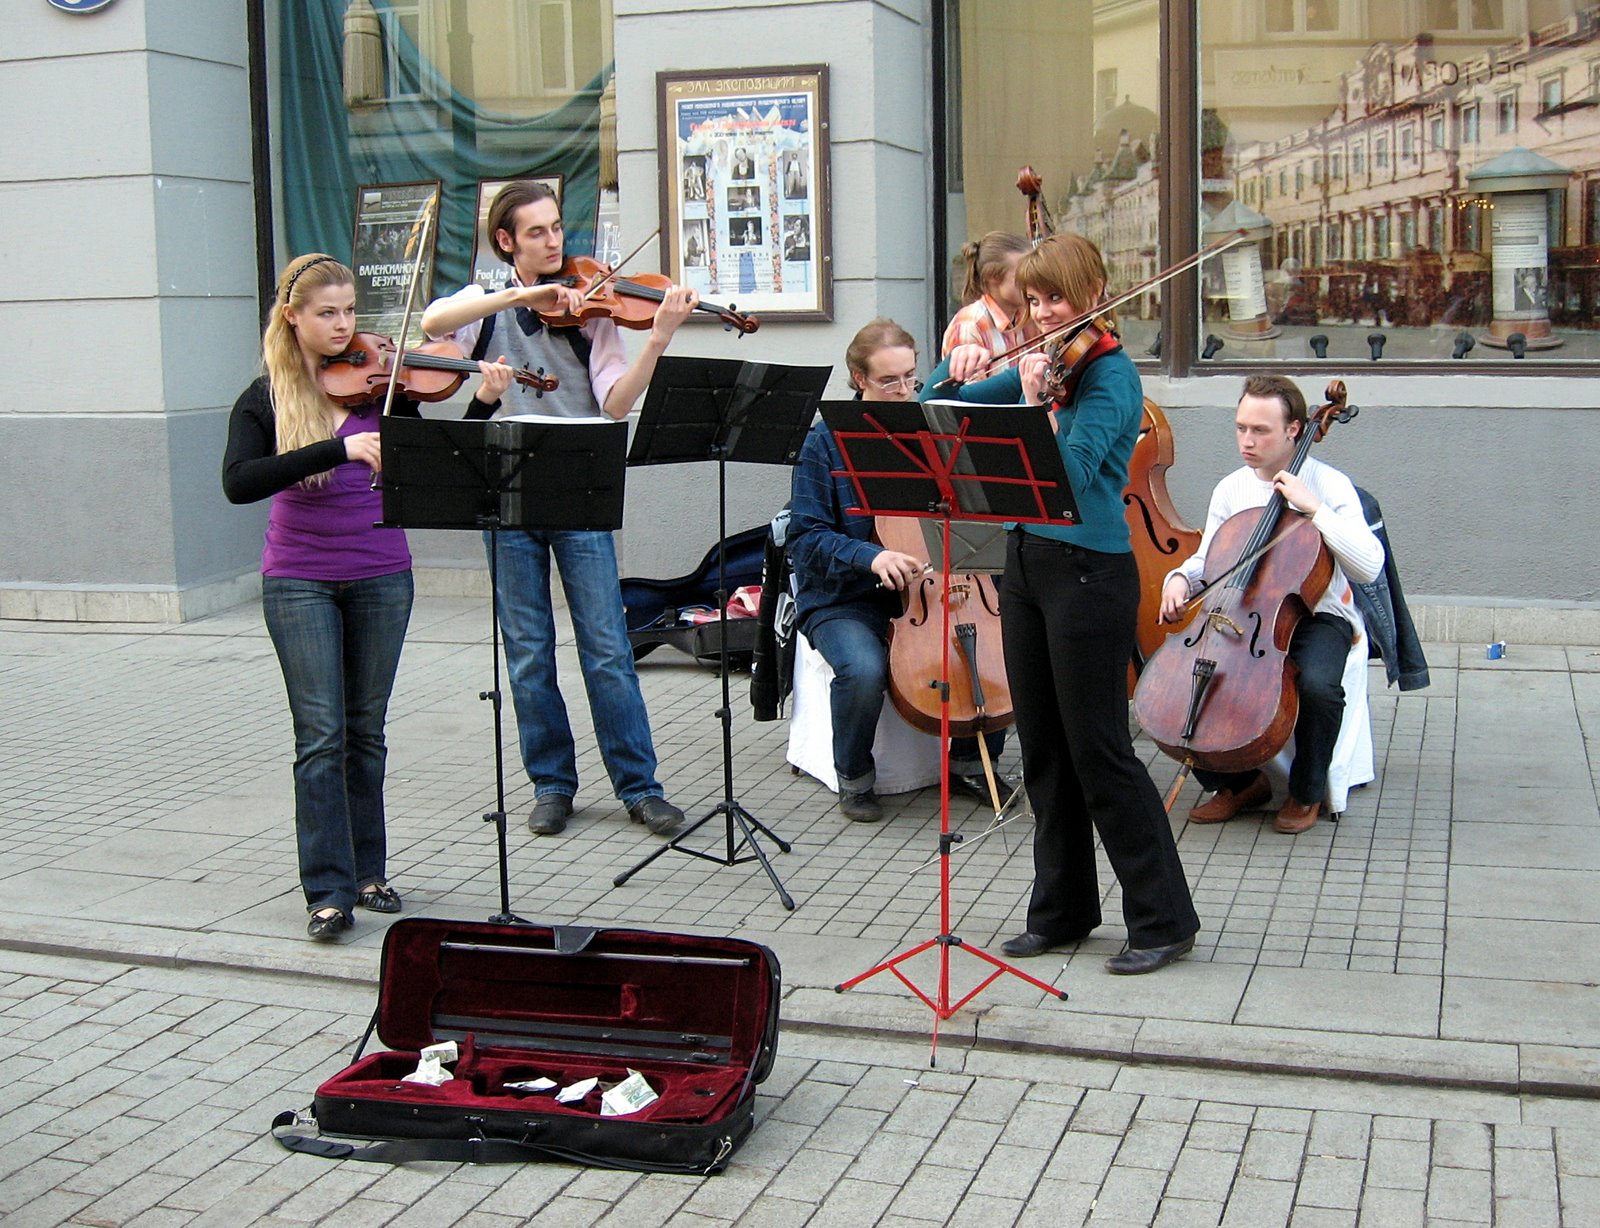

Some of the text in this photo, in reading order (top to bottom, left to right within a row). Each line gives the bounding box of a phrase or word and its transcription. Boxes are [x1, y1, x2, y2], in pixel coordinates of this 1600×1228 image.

[687, 76, 795, 93] ЗАЛ ЭКСПОЗИЦИИ
[359, 262, 425, 276] ВАЛЕНСИАНСКЕ
[475, 268, 508, 280] Fool for
[371, 274, 411, 287] БЕЗУМЦЫ
